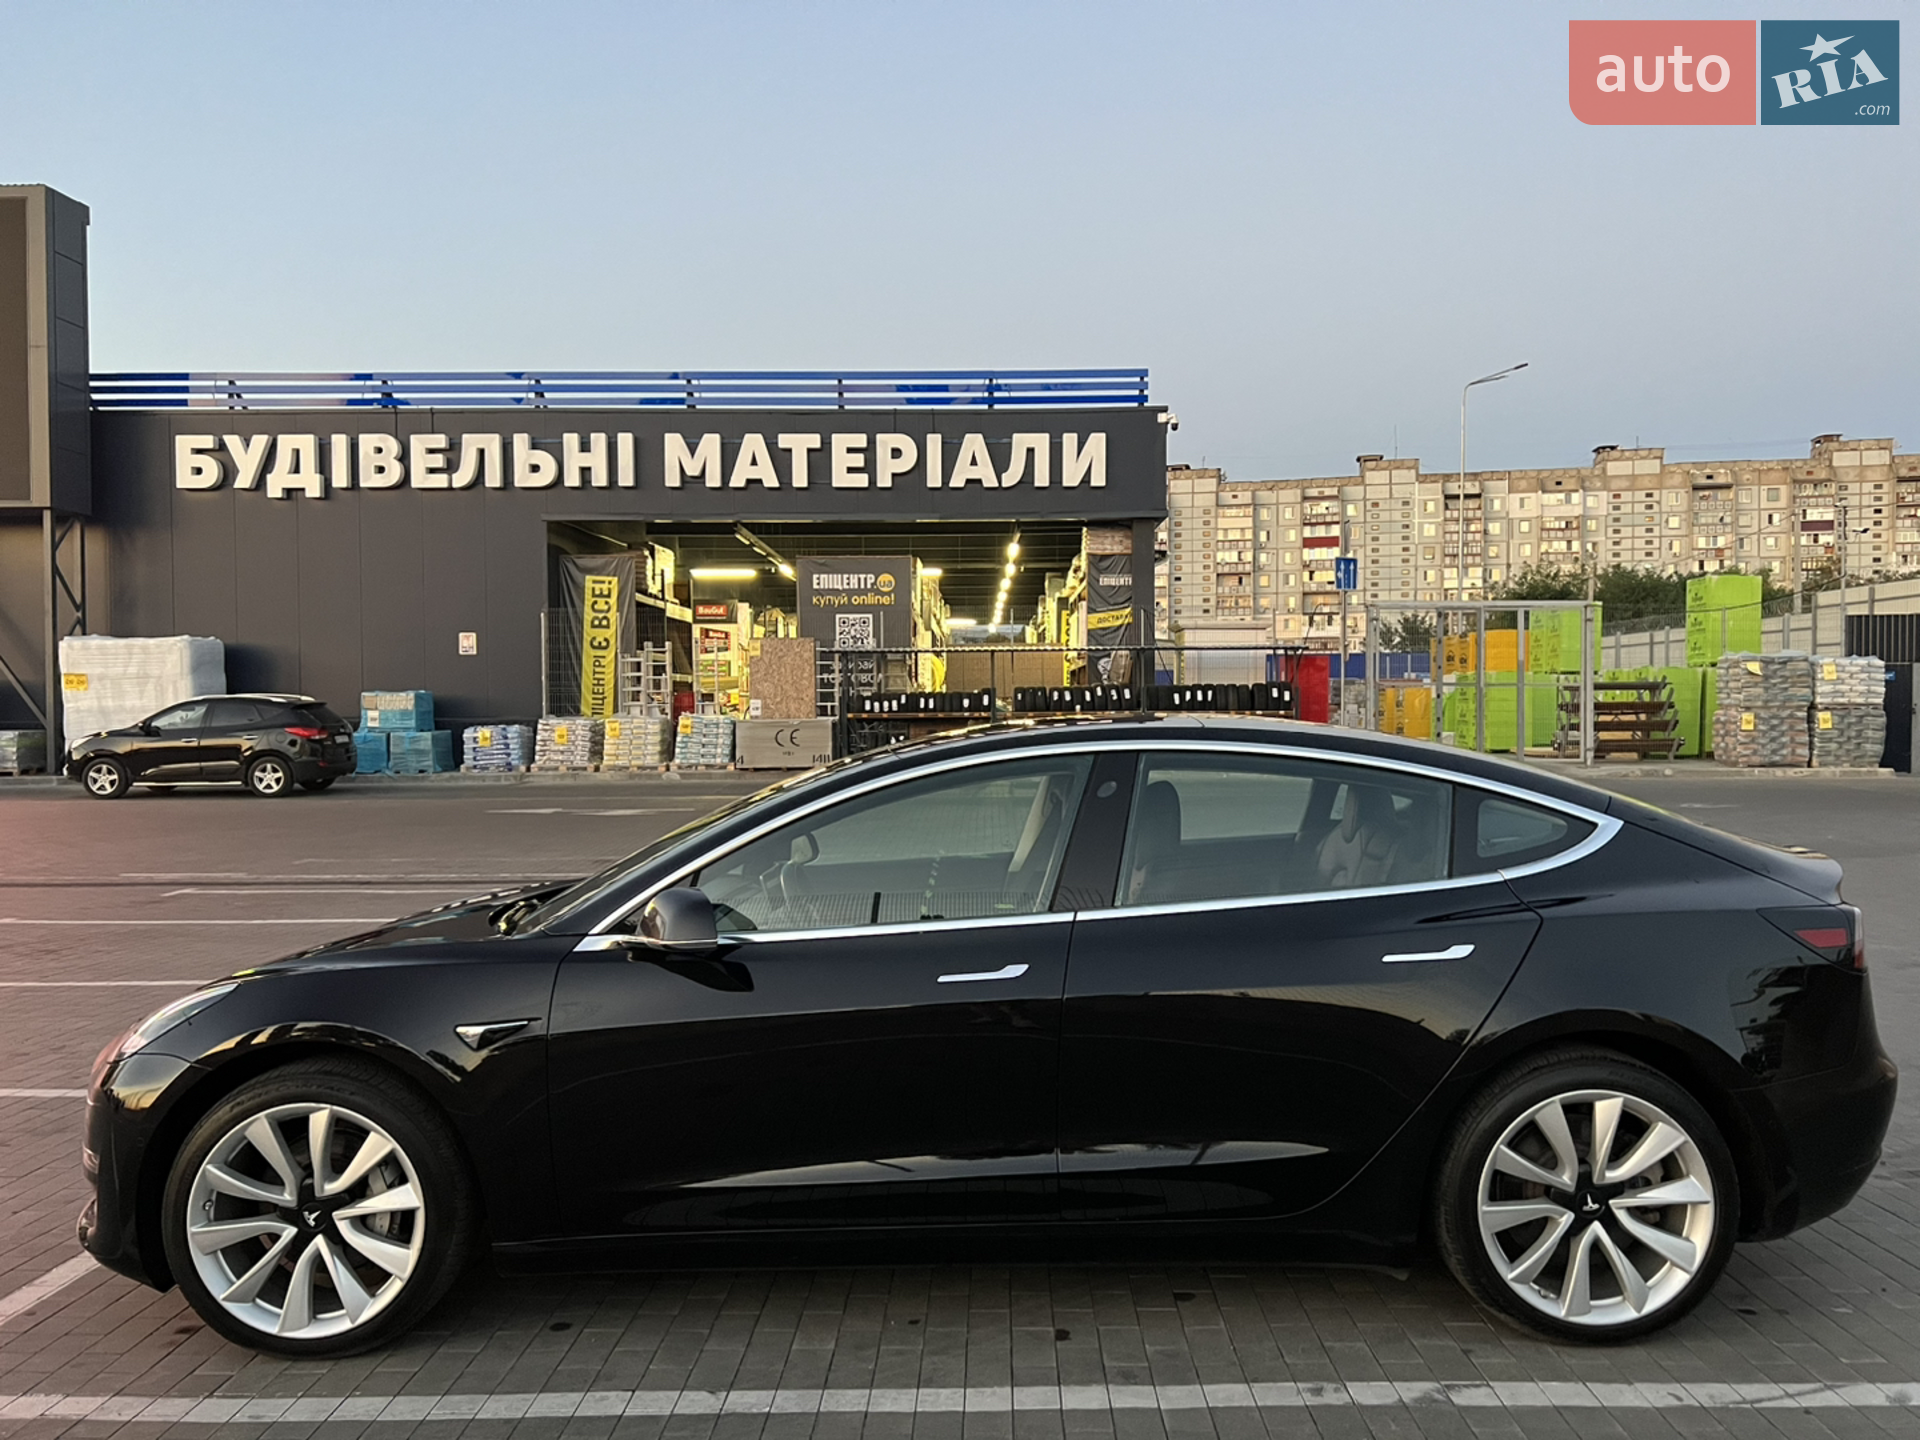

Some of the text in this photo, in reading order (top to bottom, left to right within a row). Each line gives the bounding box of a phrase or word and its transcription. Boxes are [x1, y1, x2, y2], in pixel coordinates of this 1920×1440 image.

[175, 432, 1108, 499] БУДІВЕЛЬНІ МАТЕРІАЛИ
[812, 592, 895, 608] купуй online!
[590, 579, 613, 718] ПІЦЕНТРІ Є ВСЕ!
[774, 728, 801, 748] CE
